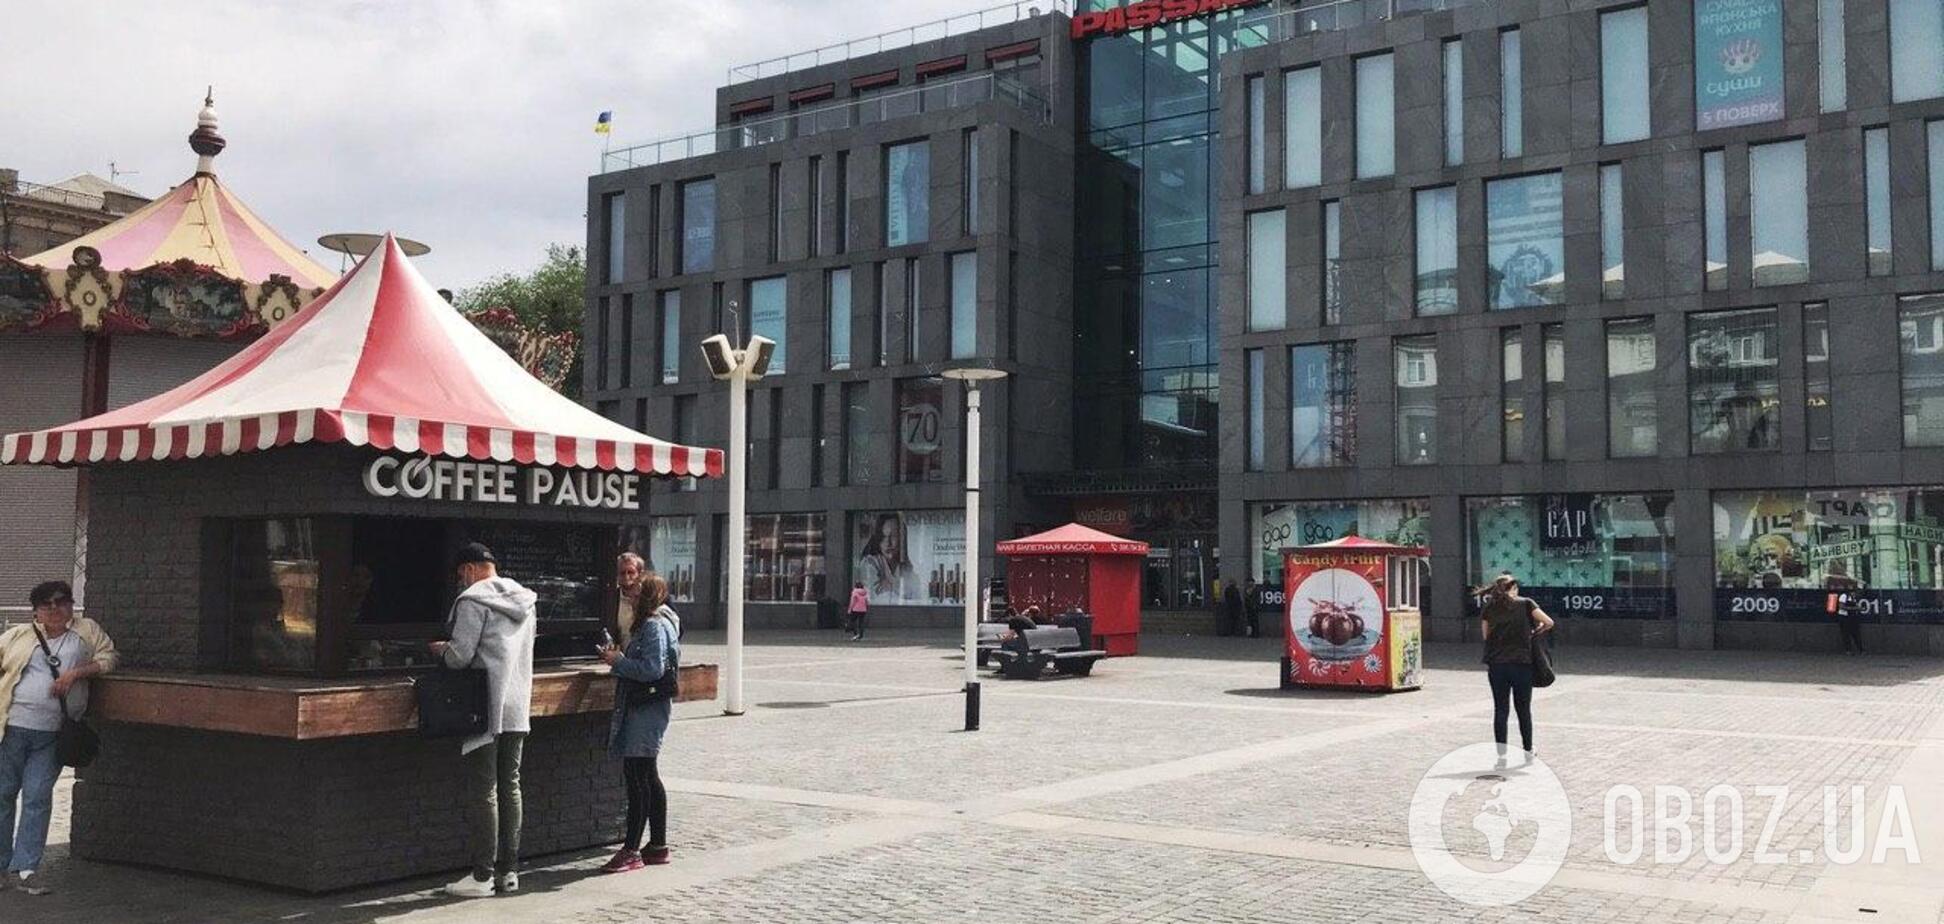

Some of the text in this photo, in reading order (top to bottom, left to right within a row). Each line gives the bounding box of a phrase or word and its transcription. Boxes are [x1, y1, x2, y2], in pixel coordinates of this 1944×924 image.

[1717, 101, 1779, 121] ПОВЕРХ
[906, 411, 939, 443] 70
[363, 455, 641, 509] COFFEE PAUSE
[1548, 510, 1586, 538] GAP
[1016, 544, 1062, 552] БИЛЕТНАЯ
[1062, 544, 1097, 552] КАССА
[1813, 539, 1868, 559] ASHBURY
[1292, 553, 1338, 569] Candy
[1562, 595, 1604, 610] 1992
[1731, 597, 1780, 613] 2009
[1857, 598, 1894, 615] 011
